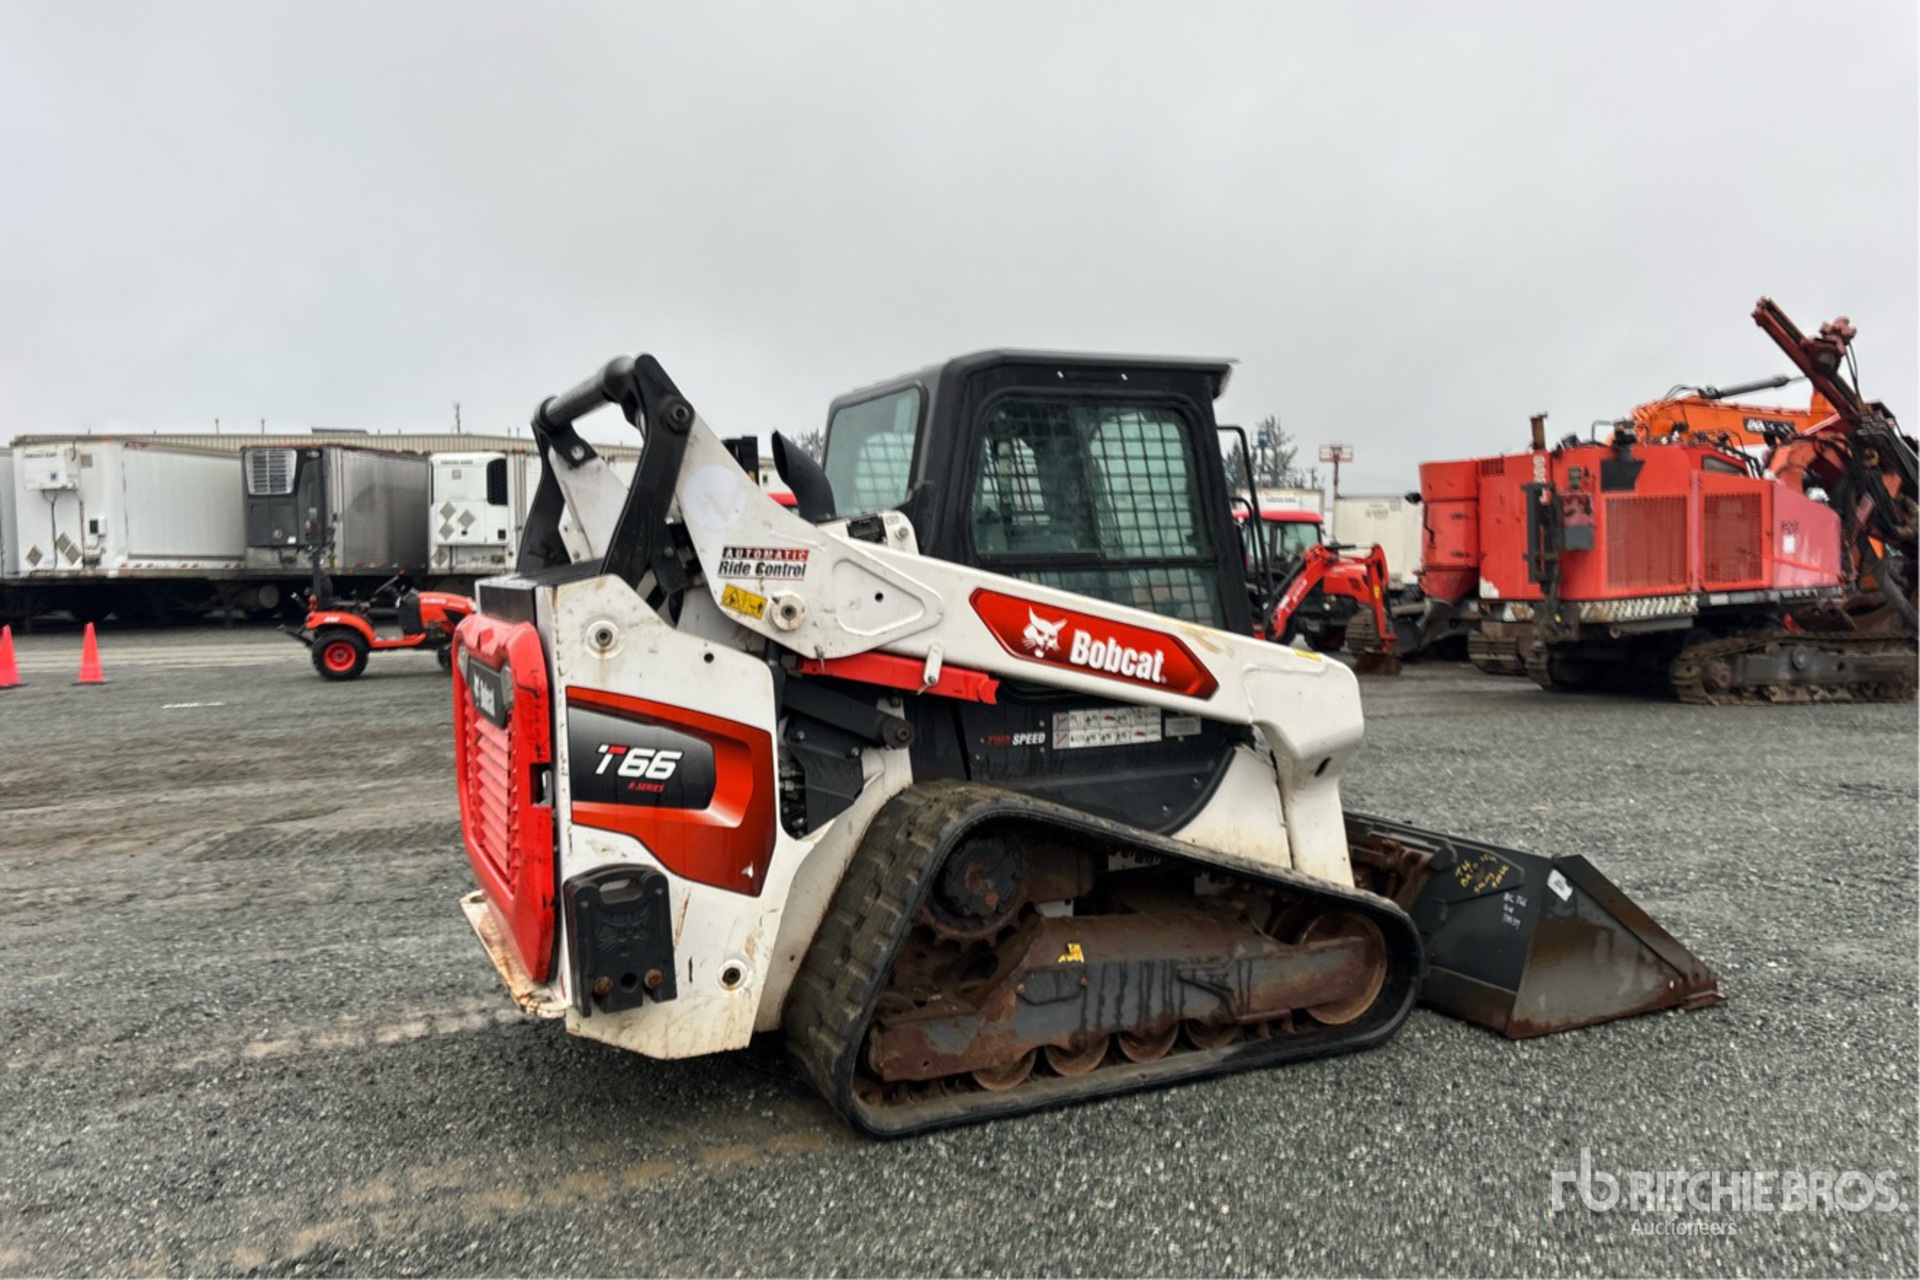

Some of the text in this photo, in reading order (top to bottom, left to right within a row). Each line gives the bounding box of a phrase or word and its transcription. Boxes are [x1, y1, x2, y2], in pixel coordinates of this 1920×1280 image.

[724, 548, 808, 561] AUTOMATIC
[718, 560, 807, 578] Ride Control
[1070, 628, 1164, 683] Bobcat
[1012, 731, 1046, 746] SPEED
[594, 743, 683, 780] T66
[627, 781, 665, 793] R-SERIES
